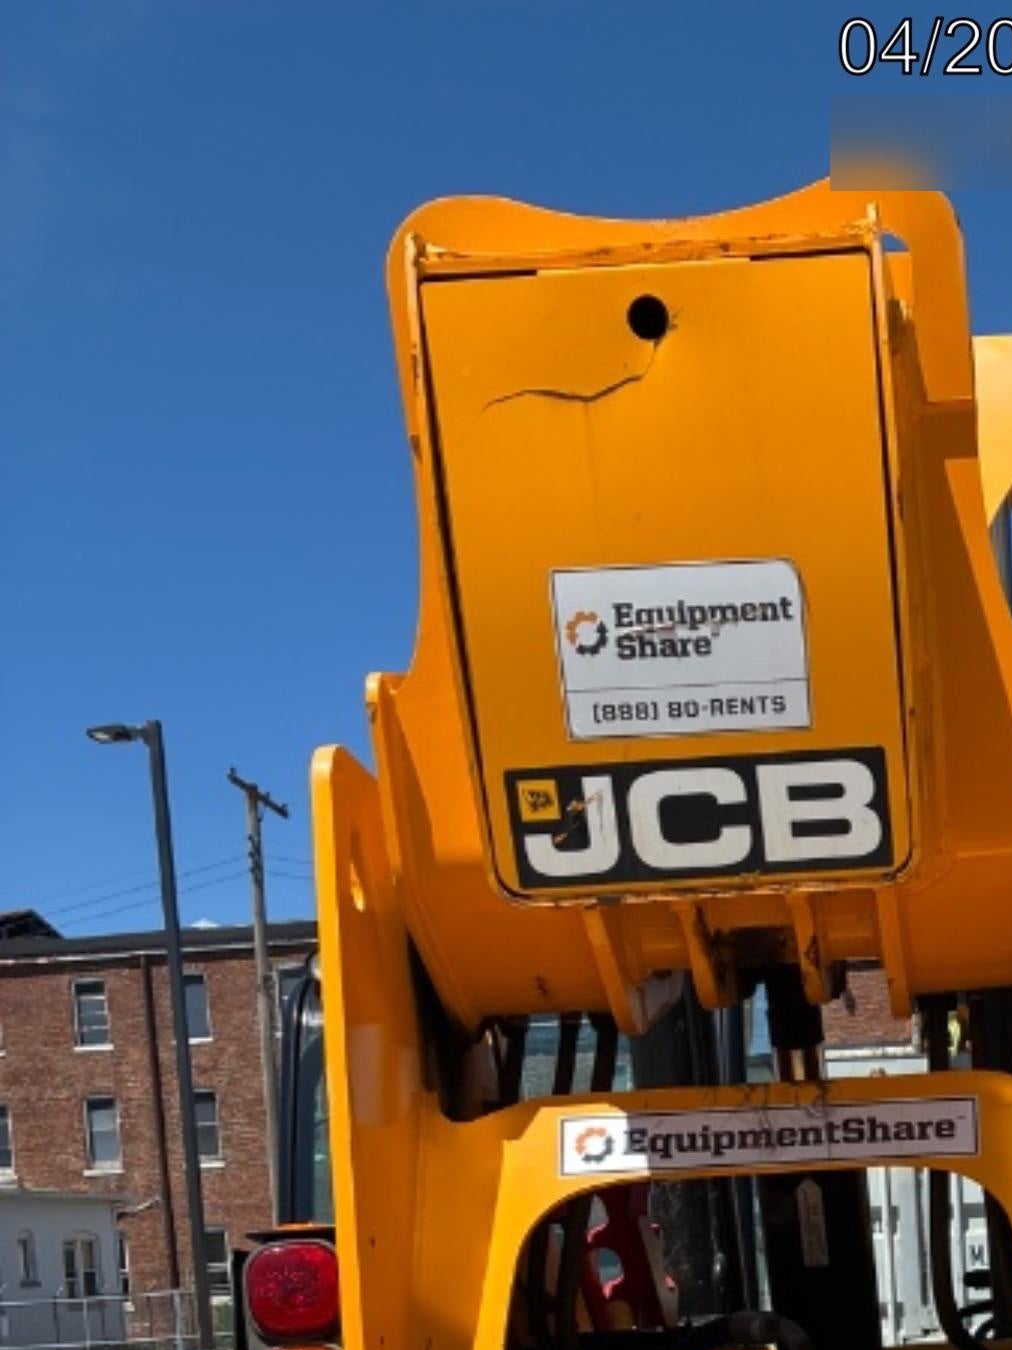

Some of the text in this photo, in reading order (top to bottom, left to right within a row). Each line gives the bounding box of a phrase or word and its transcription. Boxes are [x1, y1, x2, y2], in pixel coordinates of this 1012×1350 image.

[612, 597, 795, 631] Equipment
[668, 696, 787, 718] 80-RENTS
[524, 759, 883, 877] JCB
